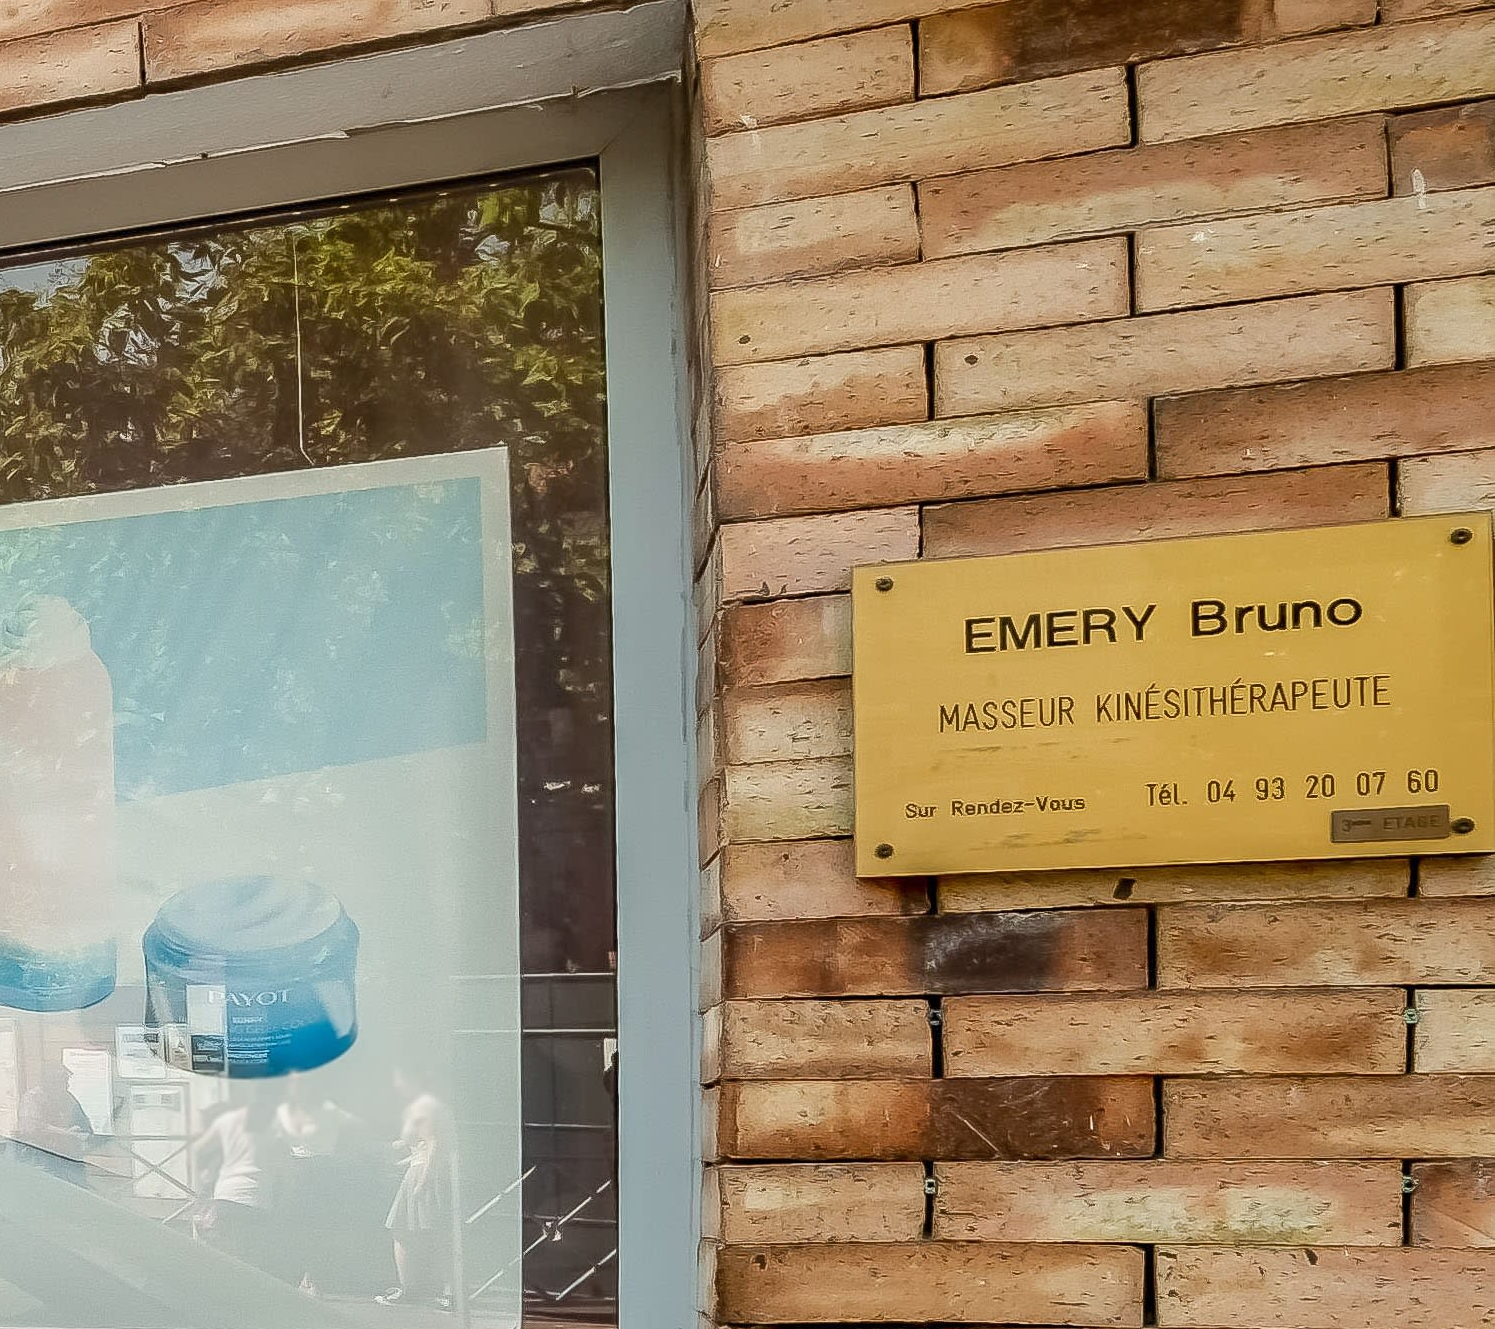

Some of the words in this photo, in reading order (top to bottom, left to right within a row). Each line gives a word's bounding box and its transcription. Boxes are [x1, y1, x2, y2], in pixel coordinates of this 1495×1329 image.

[964, 603, 1157, 655] EMERY
[1190, 596, 1364, 637] Bruno
[938, 695, 1075, 734] MASSEUR
[1095, 674, 1392, 724] KINÉSITHÉRAPEUTE
[905, 802, 938, 819] Sur
[951, 795, 1086, 818] Rendez-Vous
[1146, 782, 1189, 809] Tél.
[1206, 779, 1236, 805] 04
[1255, 777, 1286, 801] 93
[1305, 774, 1336, 800] 20
[1356, 771, 1387, 797] 07
[1407, 769, 1440, 794] 60
[206, 989, 290, 1007] PAYOT
